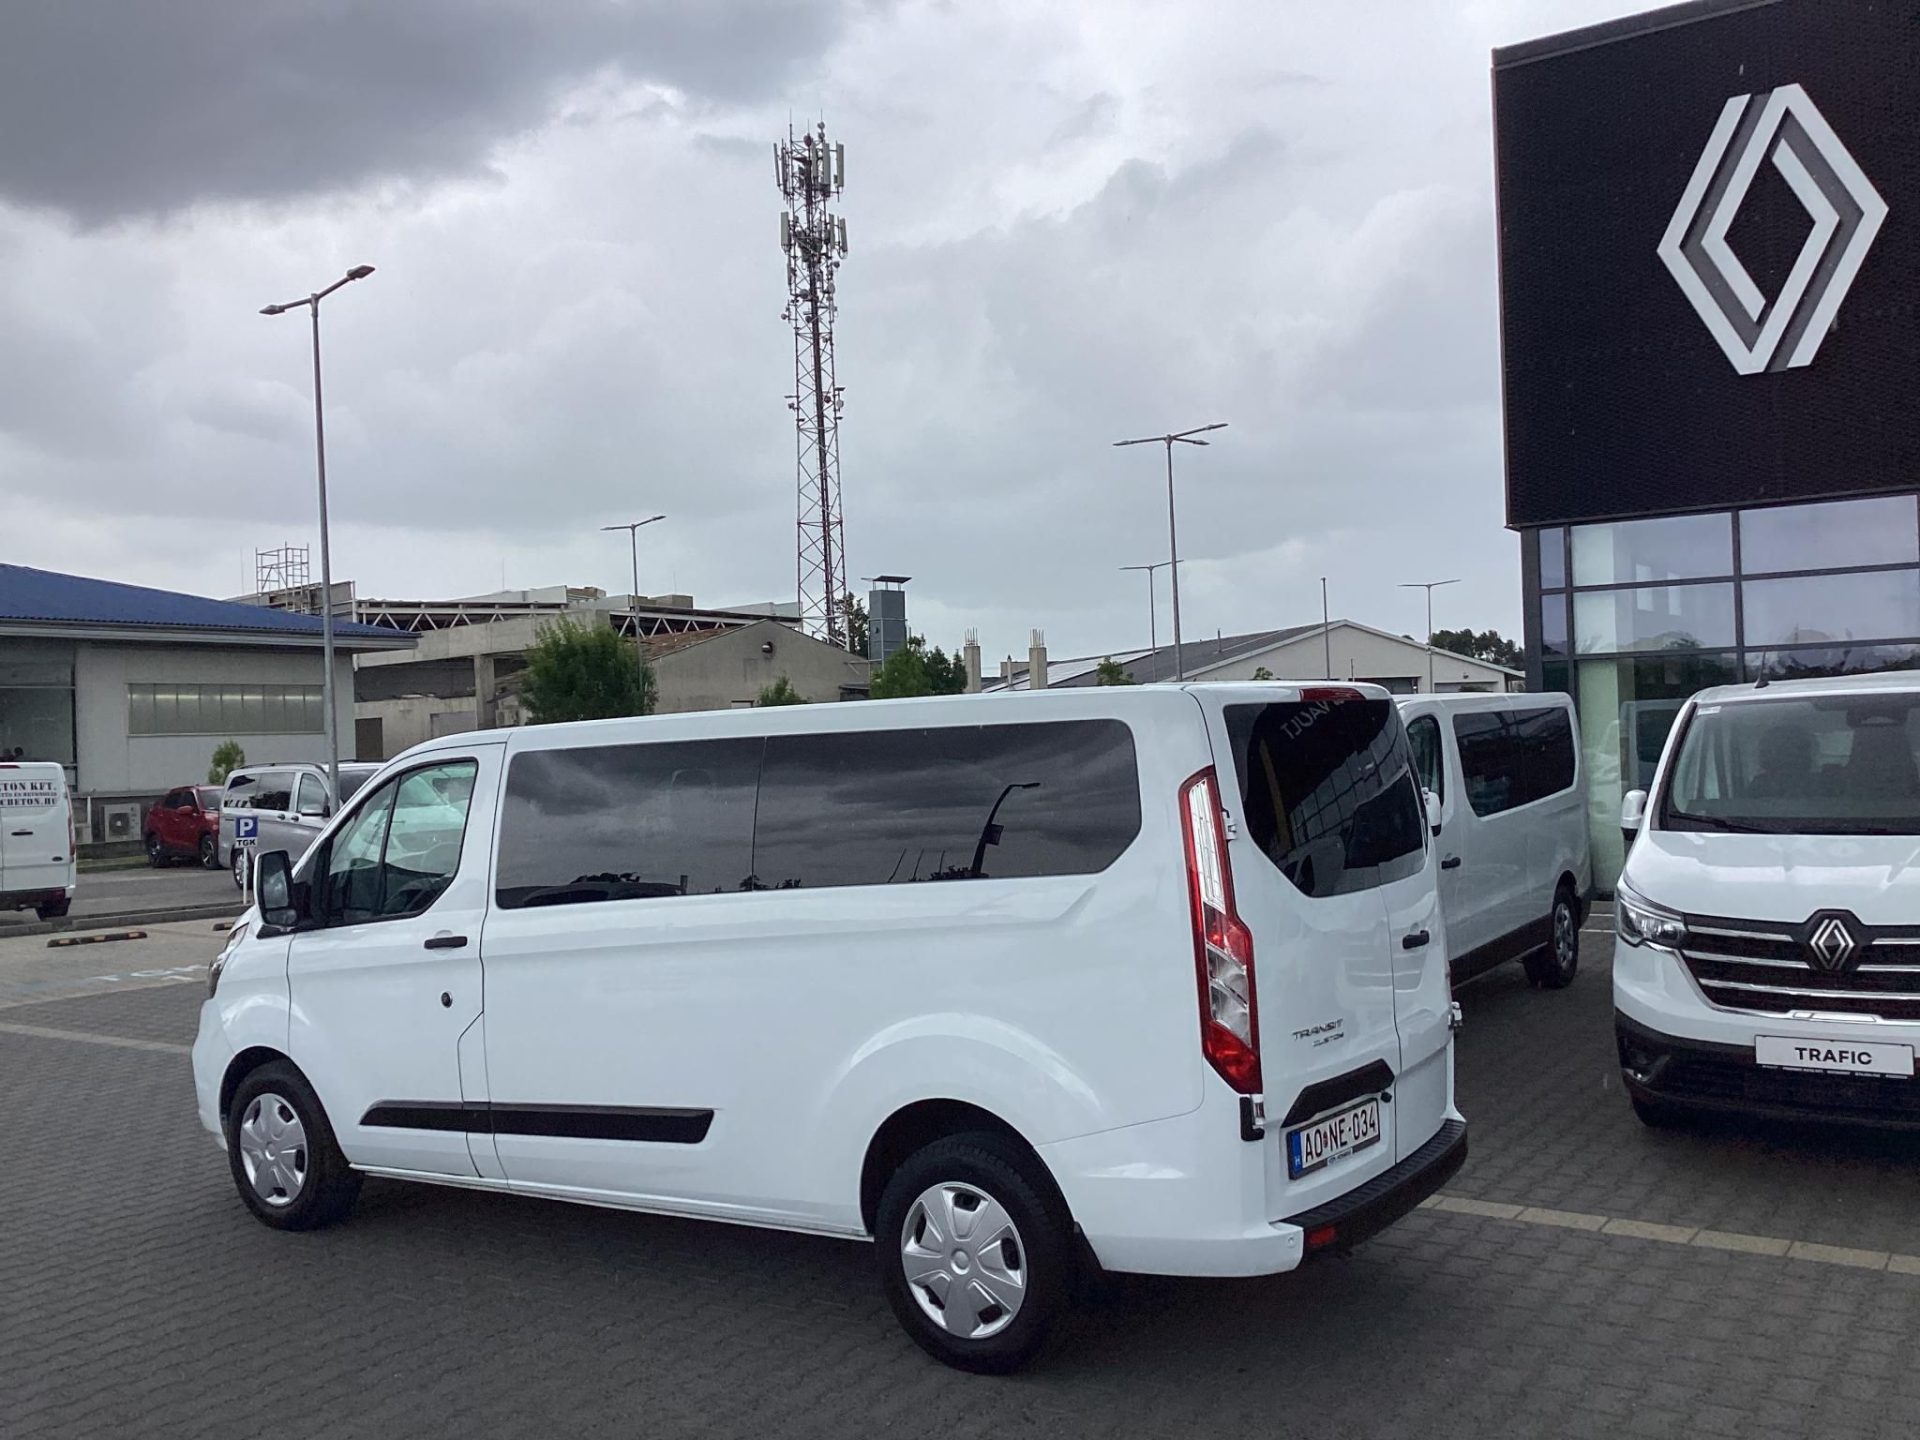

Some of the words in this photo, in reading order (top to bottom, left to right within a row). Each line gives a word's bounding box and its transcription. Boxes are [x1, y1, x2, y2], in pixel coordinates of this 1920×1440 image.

[239, 818, 254, 837] P
[1292, 1018, 1343, 1040] TRANSIT
[1794, 1047, 1873, 1066] TRAFIC
